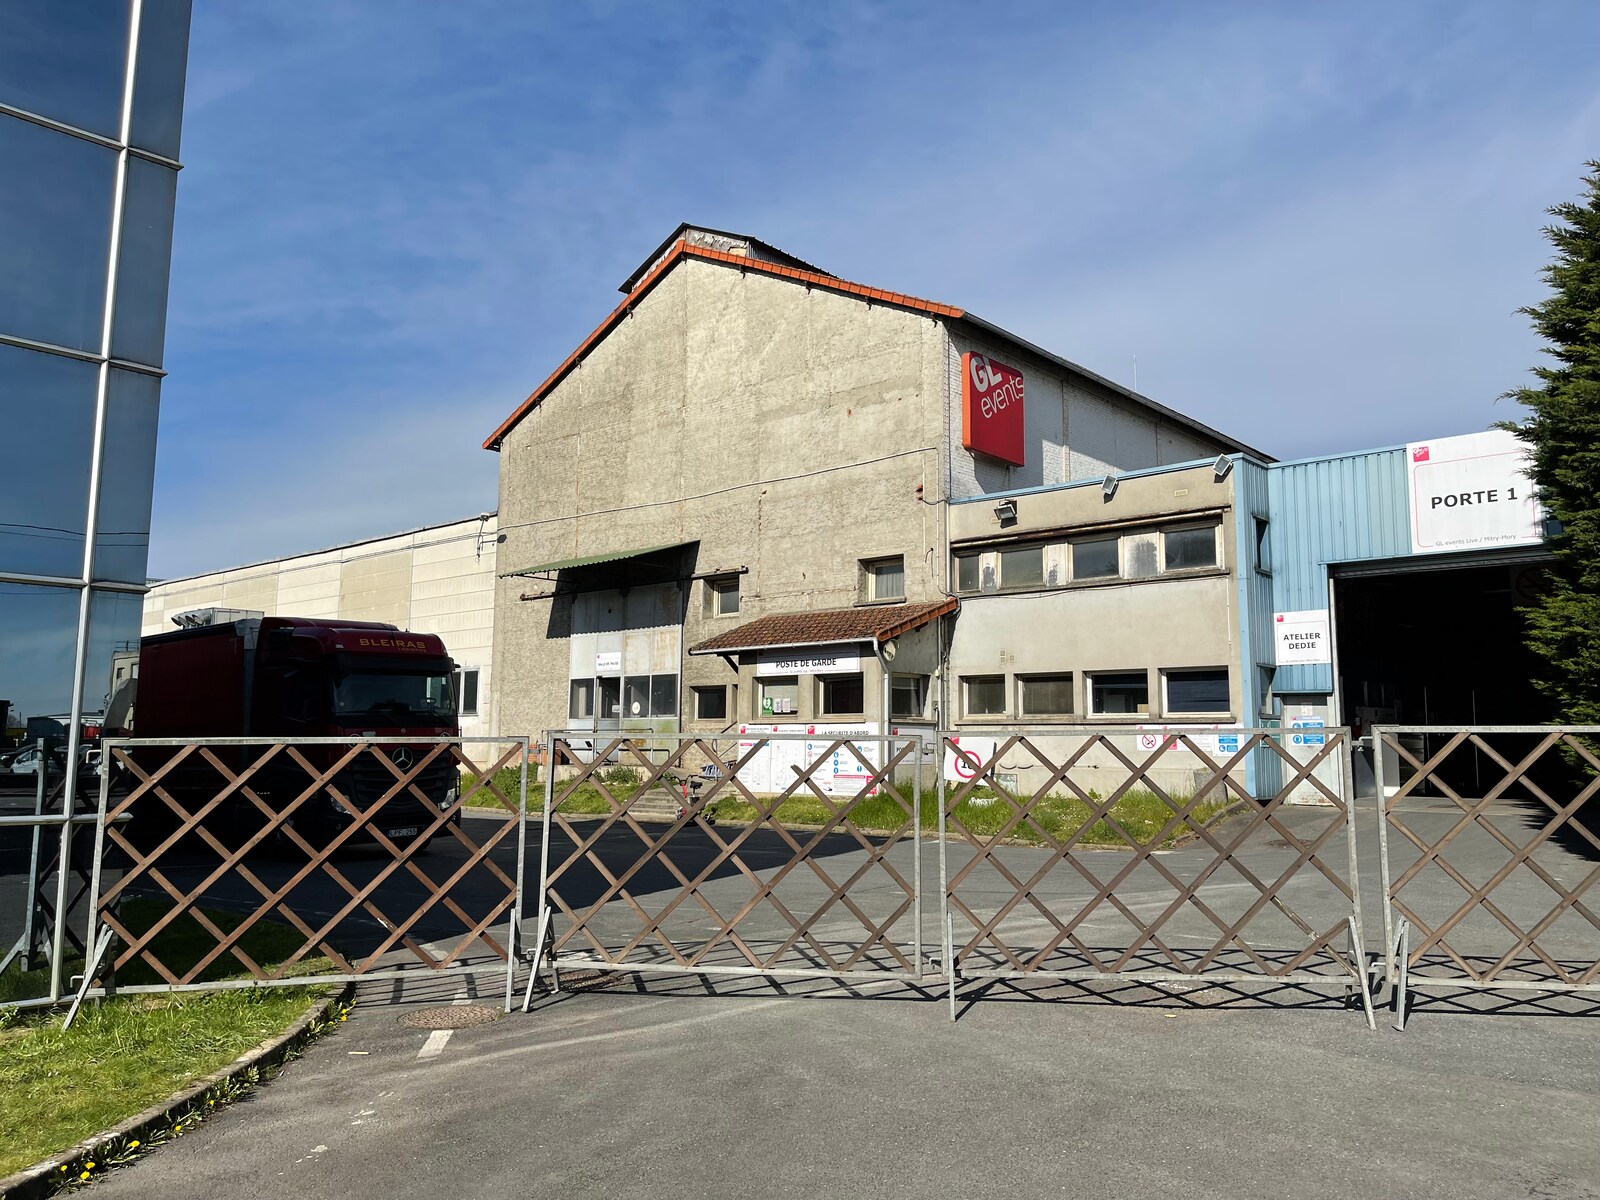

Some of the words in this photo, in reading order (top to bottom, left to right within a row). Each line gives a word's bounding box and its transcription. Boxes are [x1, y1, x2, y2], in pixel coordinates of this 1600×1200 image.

[970, 356, 1002, 393] GL
[981, 375, 1024, 419] events
[1431, 489, 1498, 509] PORTE
[1507, 487, 1518, 500] 1
[1484, 534, 1517, 542] Mitry-Mory
[1283, 632, 1321, 641] ATELIER
[360, 638, 426, 648] BLEIRAS
[1288, 641, 1317, 650] DEDIE
[775, 660, 799, 669] POSTE
[800, 659, 810, 667] DE
[812, 658, 837, 667] GARDE
